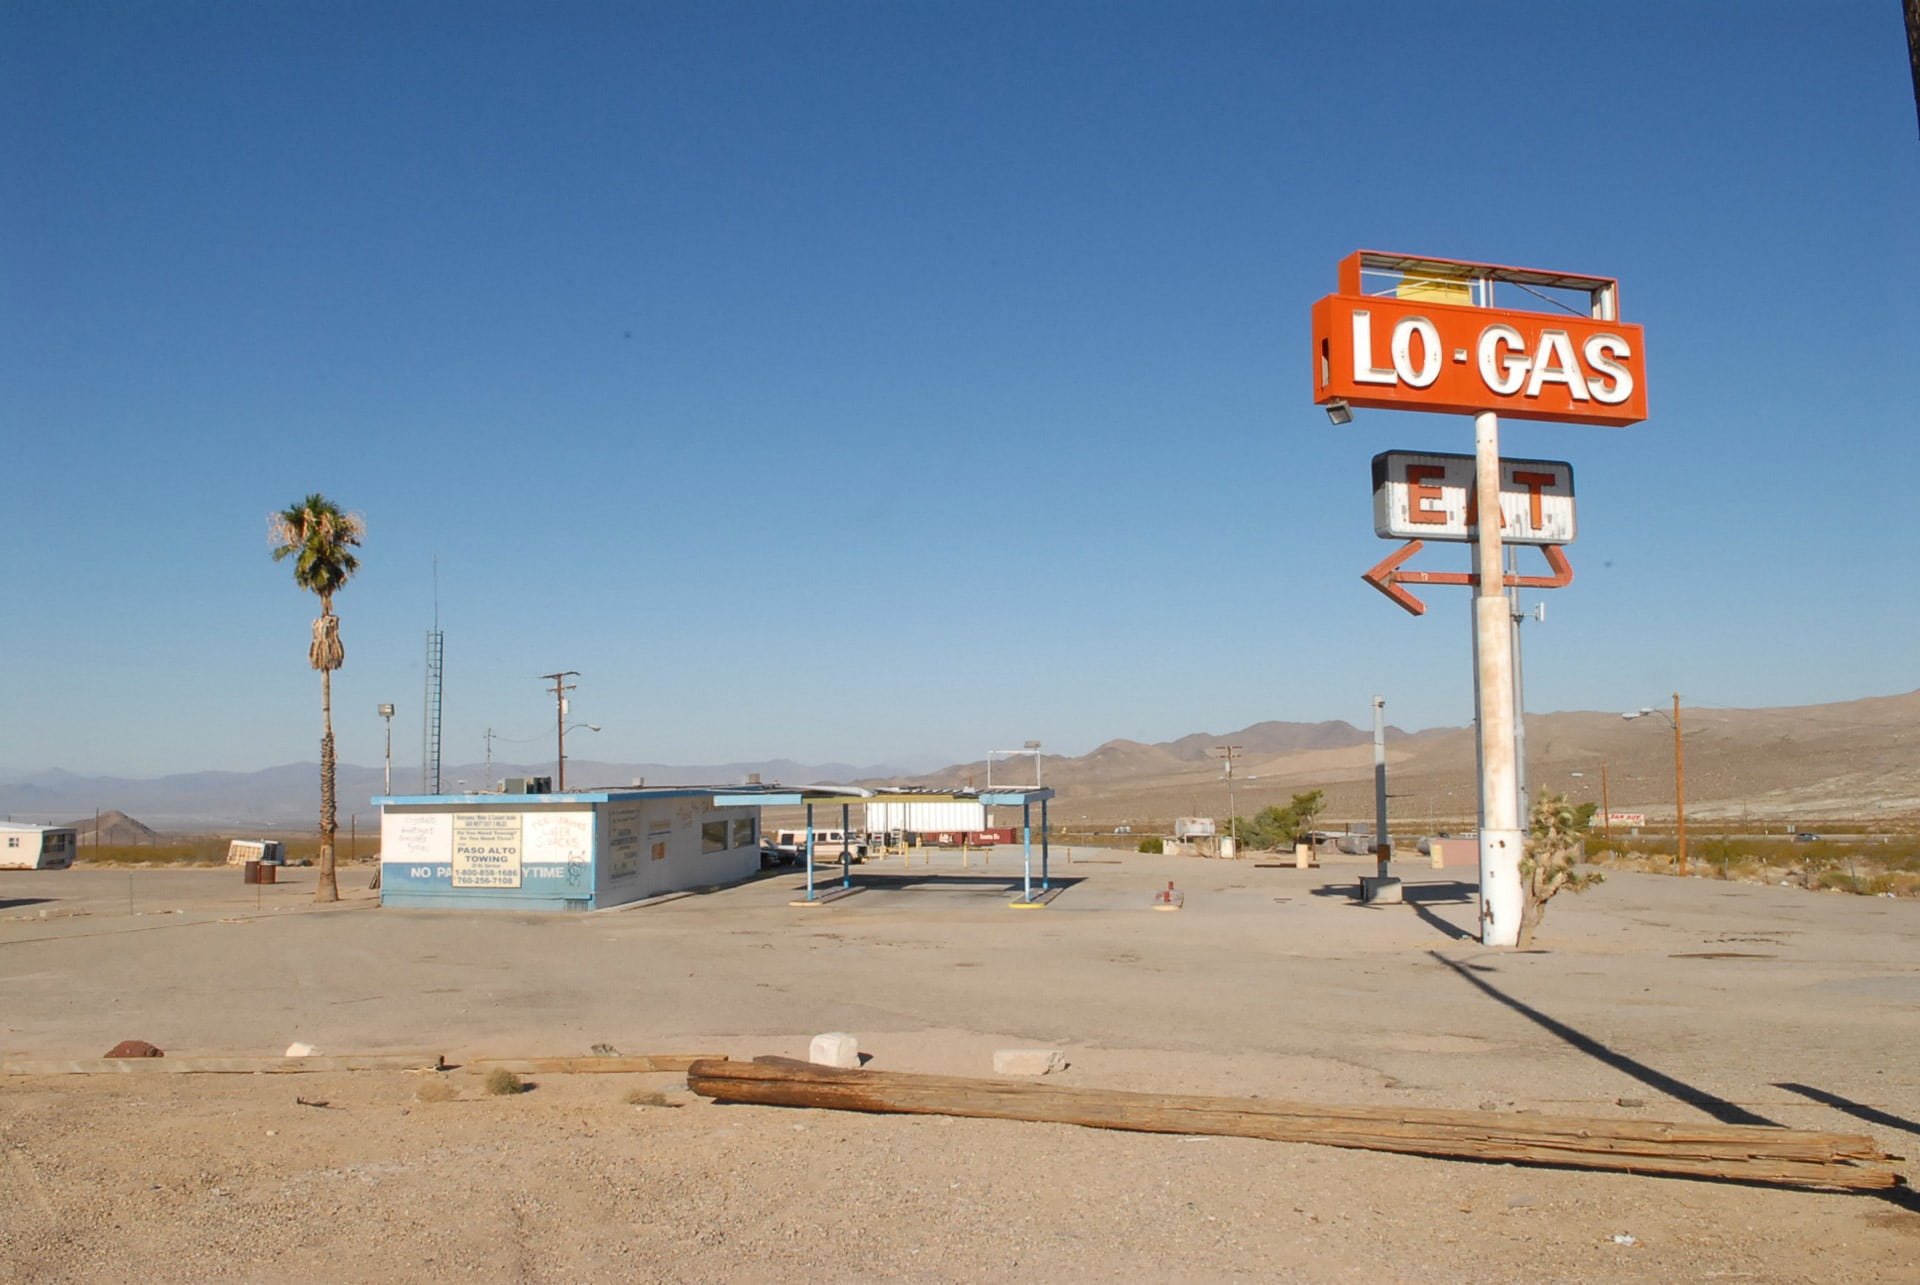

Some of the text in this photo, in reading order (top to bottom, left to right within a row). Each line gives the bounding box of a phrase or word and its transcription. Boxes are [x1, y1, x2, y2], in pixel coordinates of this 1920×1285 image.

[410, 867, 565, 878] NO PA YTIME
